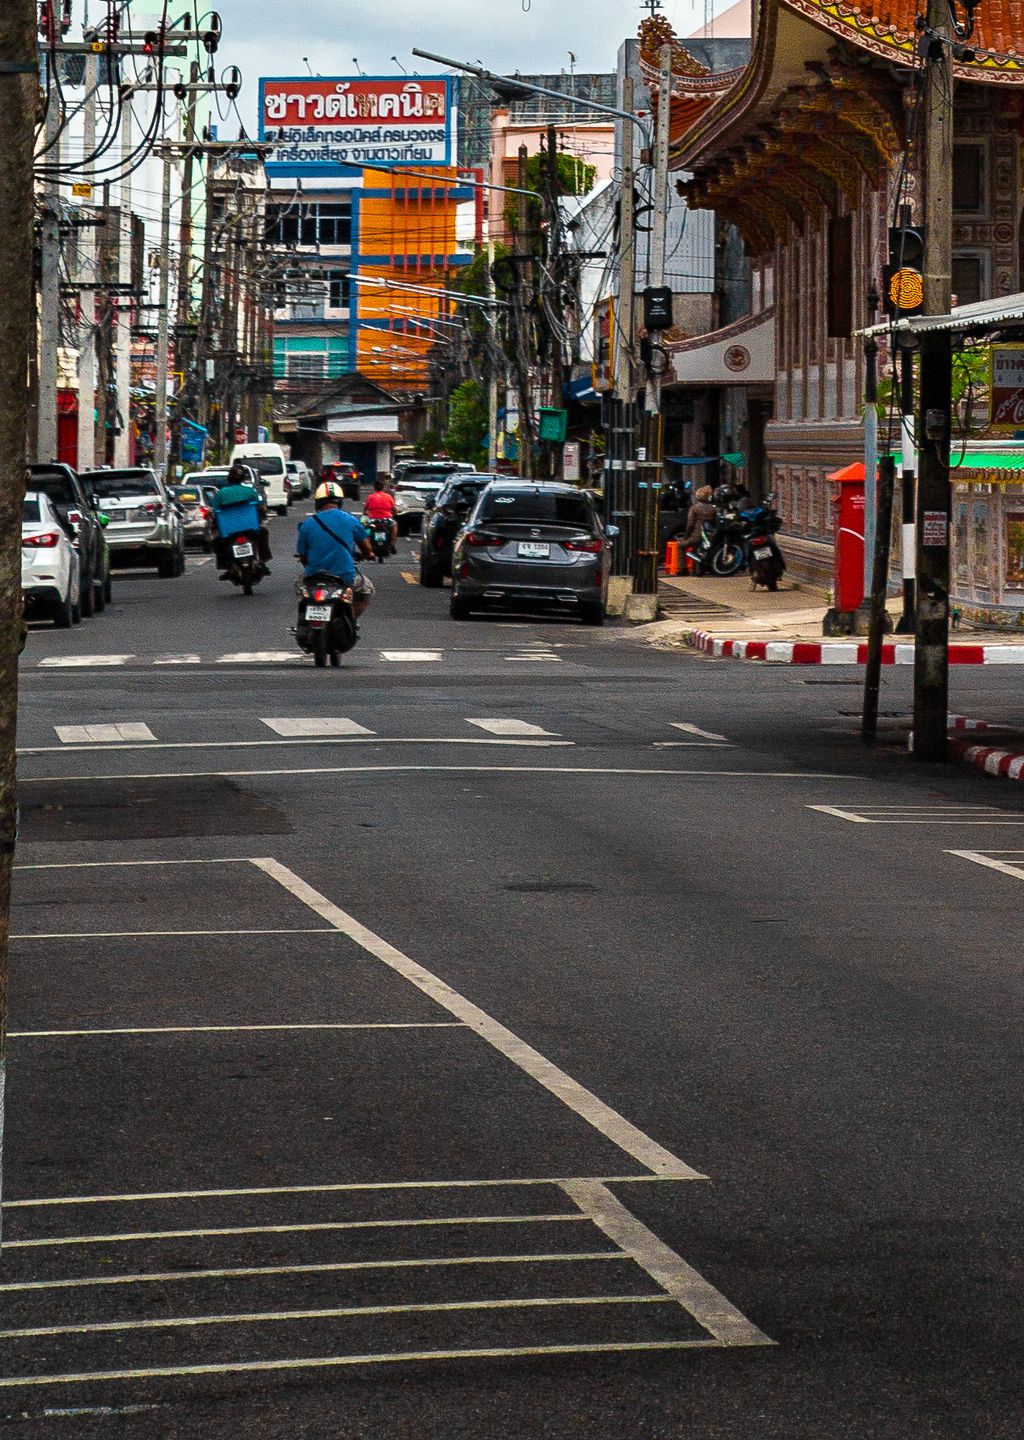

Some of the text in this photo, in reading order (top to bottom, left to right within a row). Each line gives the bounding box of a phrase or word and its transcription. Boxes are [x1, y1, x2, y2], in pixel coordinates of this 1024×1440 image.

[264, 82, 446, 119] ซาวด์เทคนิค
